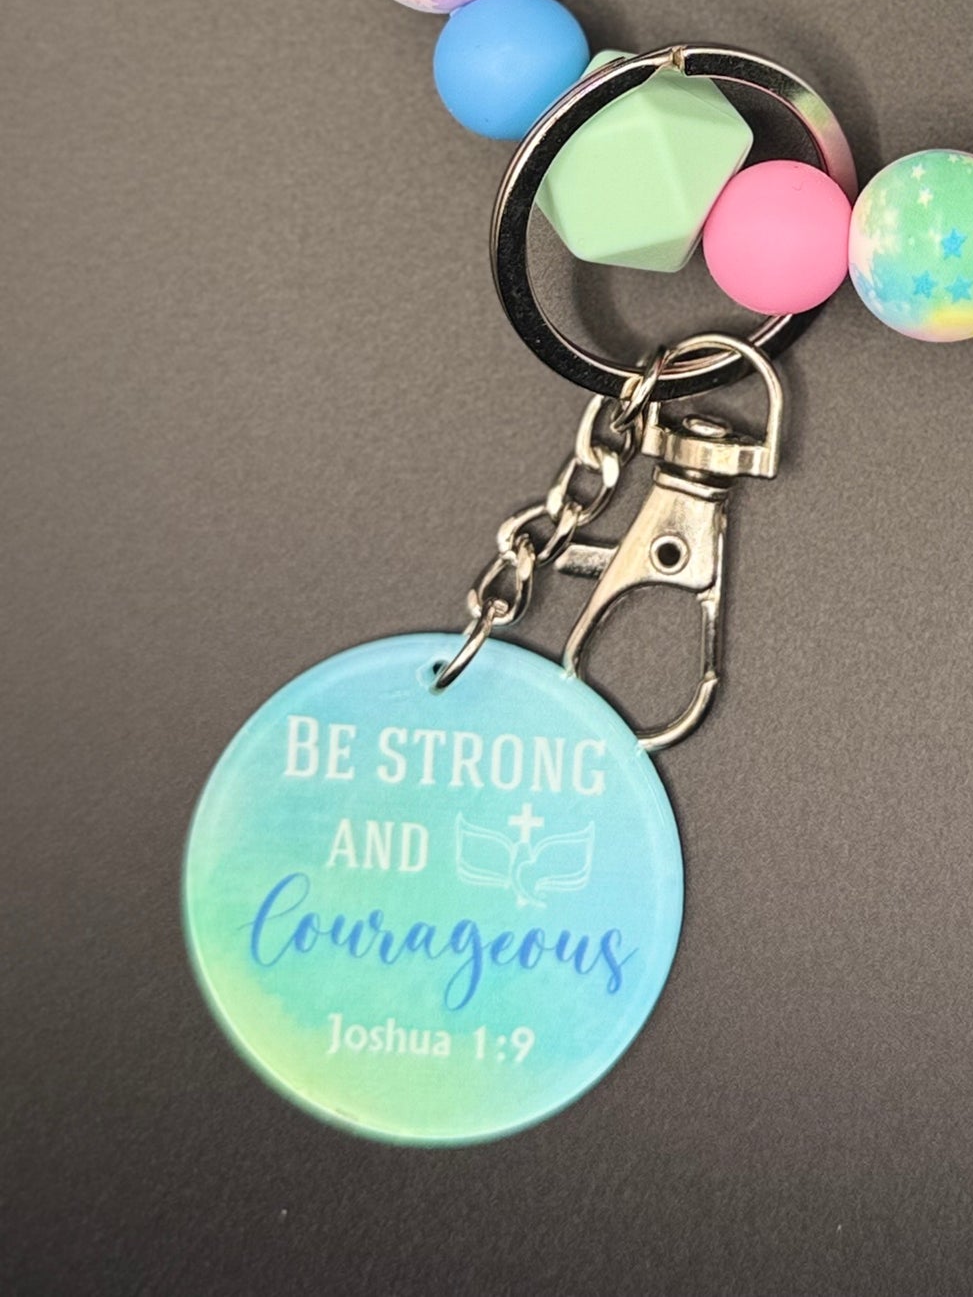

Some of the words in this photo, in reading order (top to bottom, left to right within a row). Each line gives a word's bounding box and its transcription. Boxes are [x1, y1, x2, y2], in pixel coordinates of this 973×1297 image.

[284, 714, 357, 781] BE
[376, 725, 607, 797] STRONG
[325, 817, 429, 873] AND
[238, 871, 639, 1012] Courageous
[327, 1012, 452, 1057] Joshua
[472, 1026, 536, 1064] 1:9
